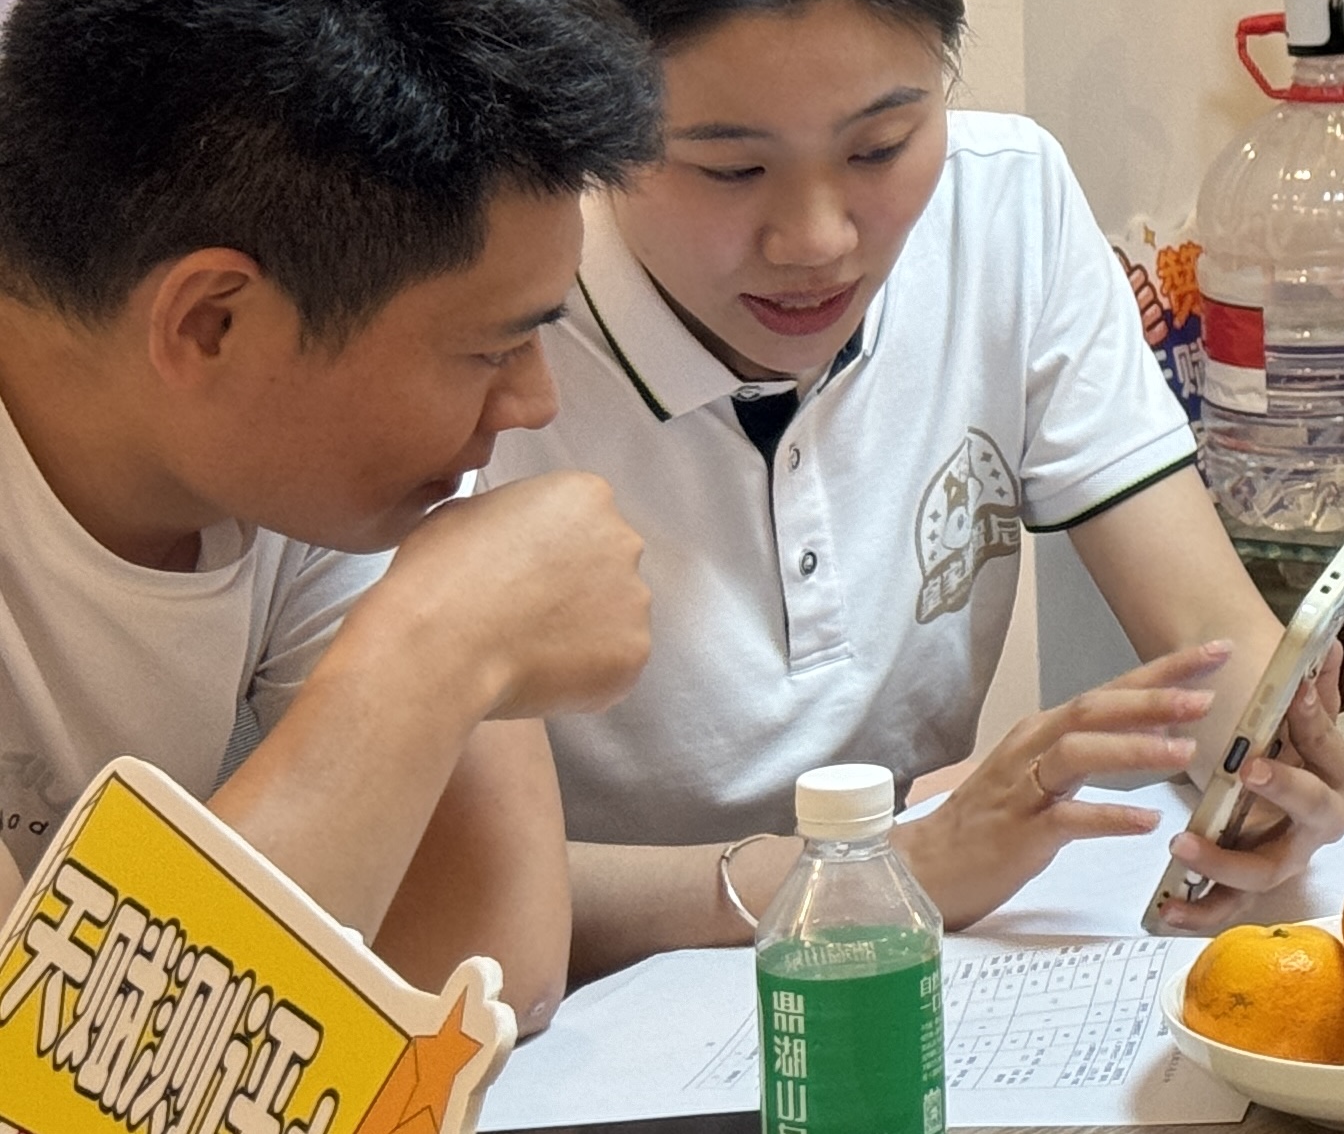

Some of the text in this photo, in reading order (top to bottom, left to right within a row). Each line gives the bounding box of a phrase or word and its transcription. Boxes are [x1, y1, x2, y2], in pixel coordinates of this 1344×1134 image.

[0, 858, 342, 1134] 天赋测评
[771, 989, 808, 1134] 鼎湖山
